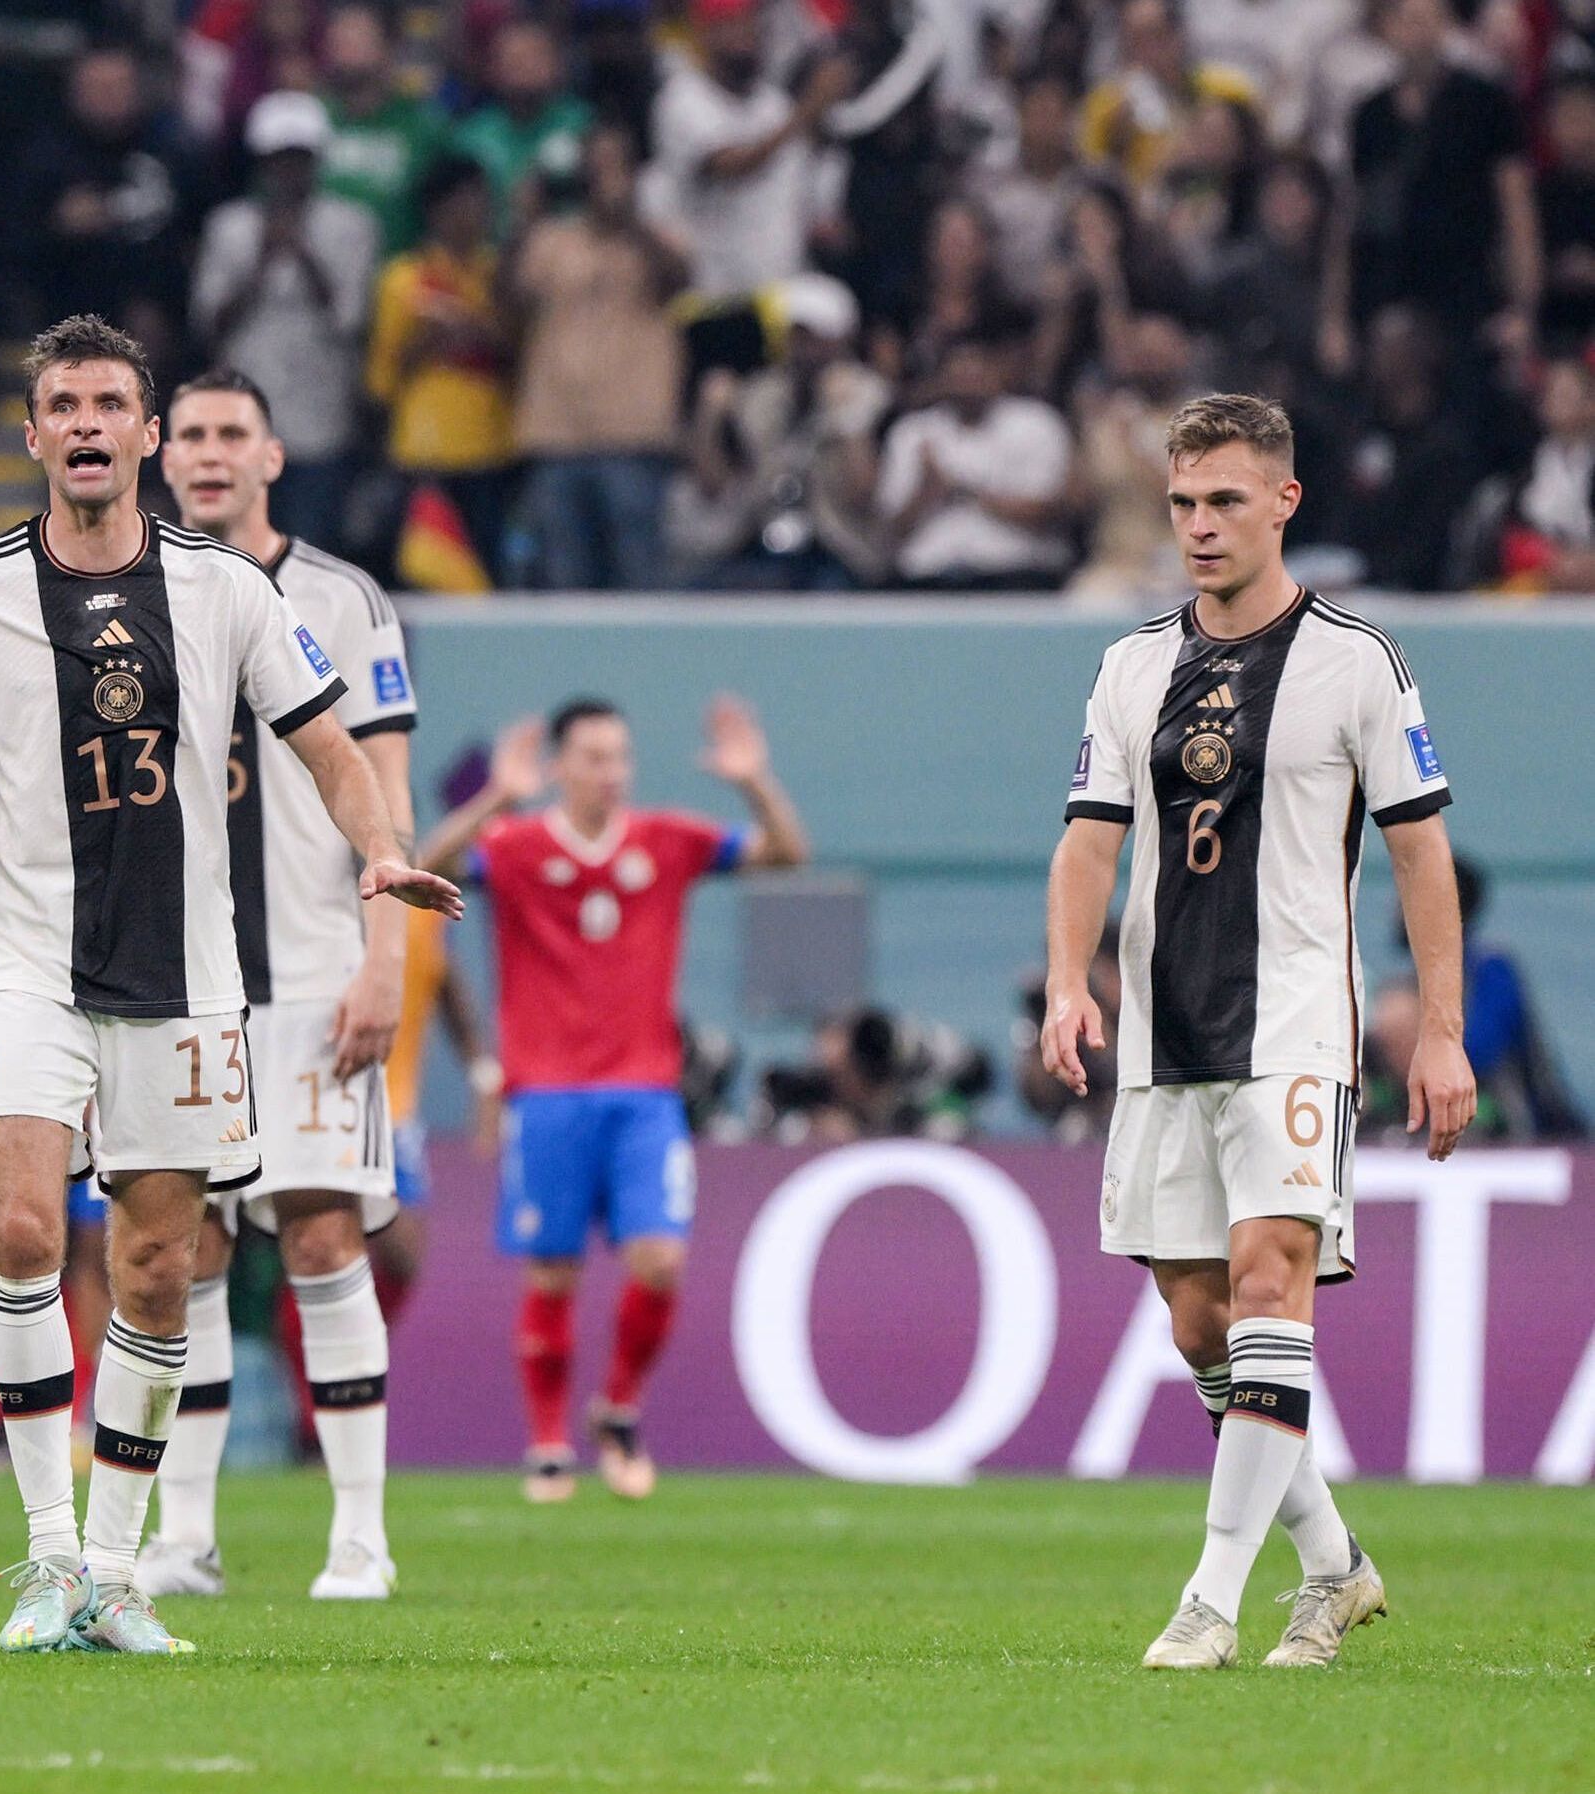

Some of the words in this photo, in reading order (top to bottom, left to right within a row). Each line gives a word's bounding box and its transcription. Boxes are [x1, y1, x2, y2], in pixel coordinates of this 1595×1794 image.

[77, 729, 167, 813] 13
[1187, 799, 1222, 874] 6
[174, 1029, 245, 1106] 13
[1285, 1075, 1323, 1147] 6
[1233, 1391, 1278, 1406] DFB
[117, 1441, 160, 1460] DFB
